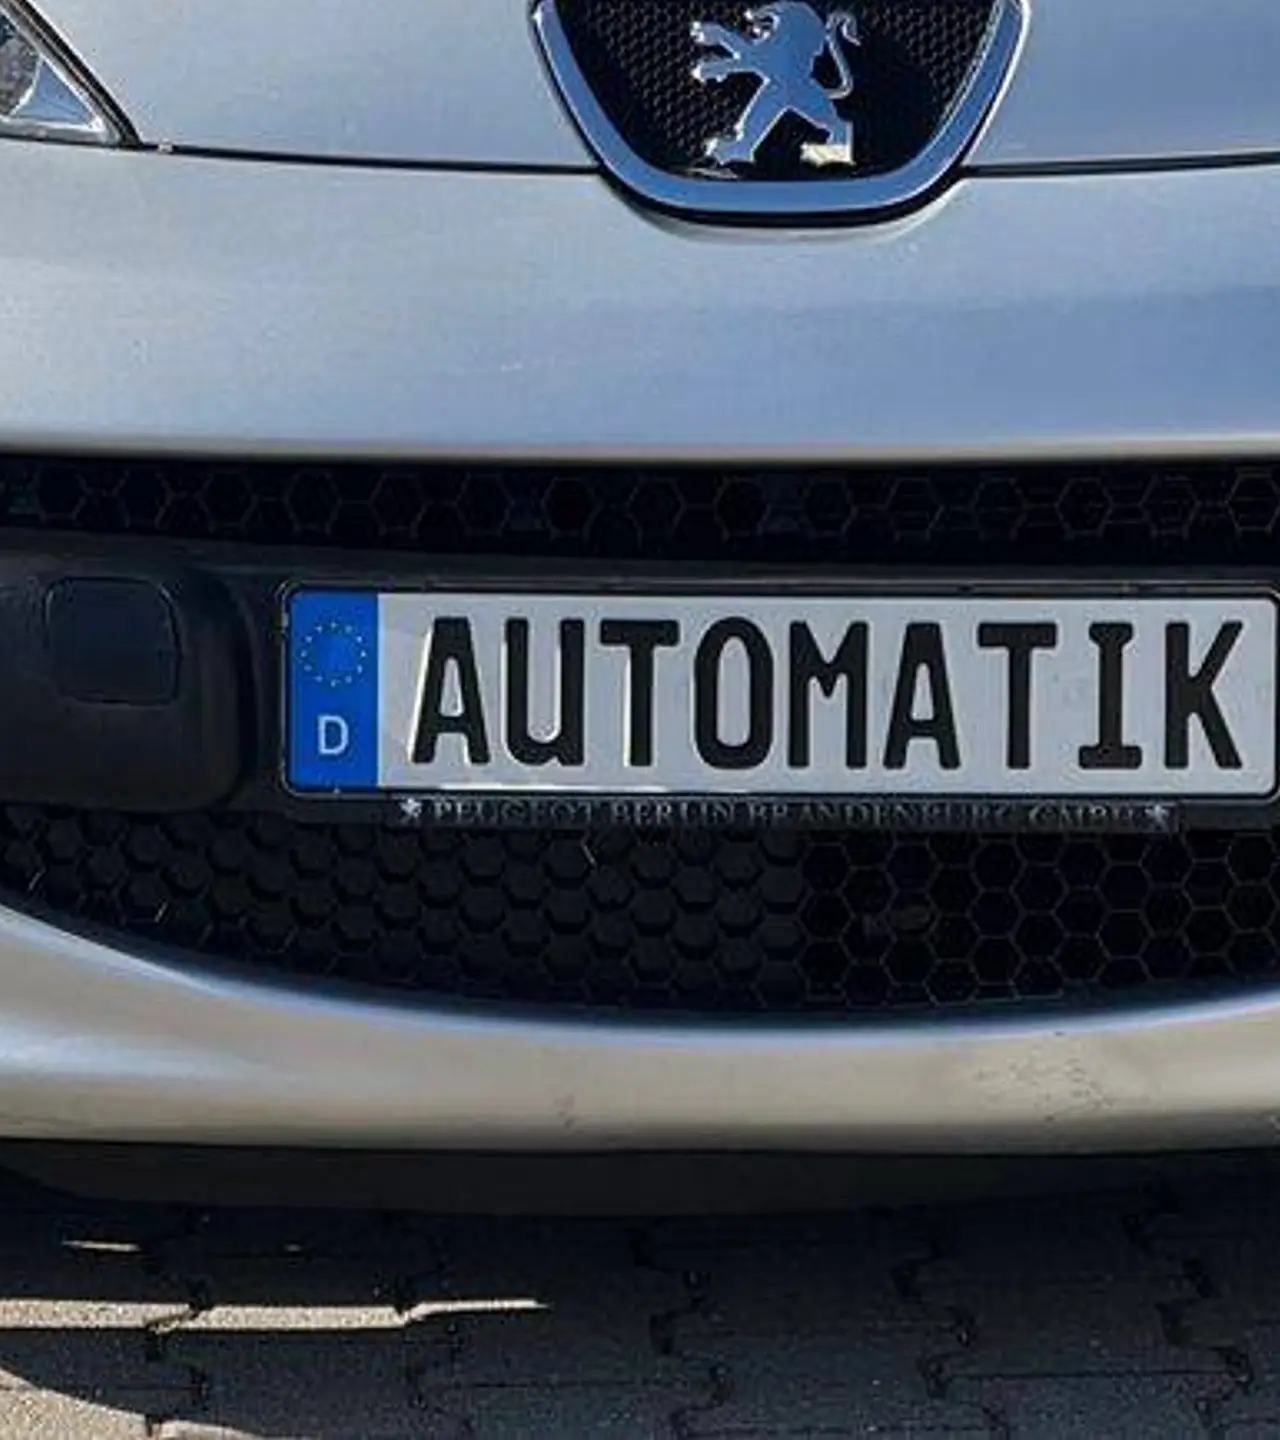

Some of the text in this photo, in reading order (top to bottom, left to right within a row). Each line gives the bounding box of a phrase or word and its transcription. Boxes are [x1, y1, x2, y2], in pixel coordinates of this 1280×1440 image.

[408, 615, 1244, 771] AUTOMATIK
[317, 714, 350, 755] D
[610, 797, 735, 825] BERLIN
